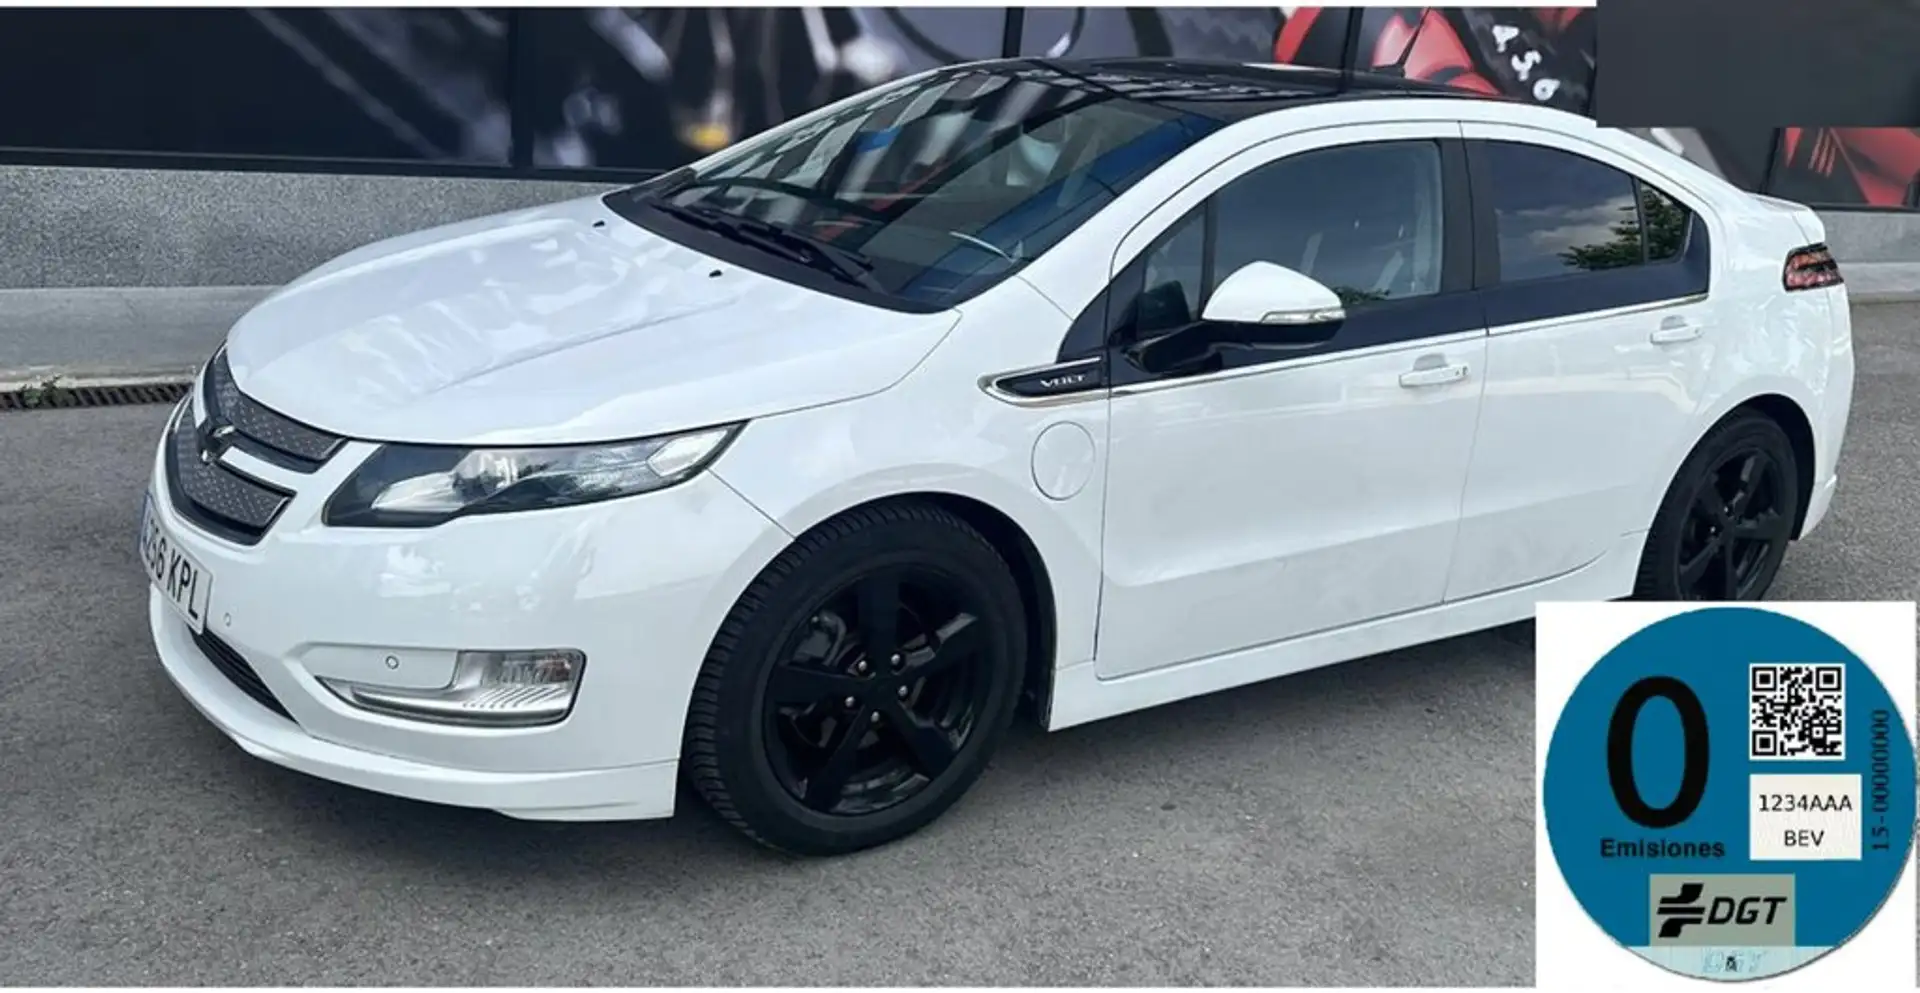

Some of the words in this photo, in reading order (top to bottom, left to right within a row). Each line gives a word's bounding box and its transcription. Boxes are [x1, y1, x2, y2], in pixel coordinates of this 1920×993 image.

[1511, 50, 1542, 81] 5
[1040, 374, 1086, 388] VOLT
[167, 548, 198, 620] KPL
